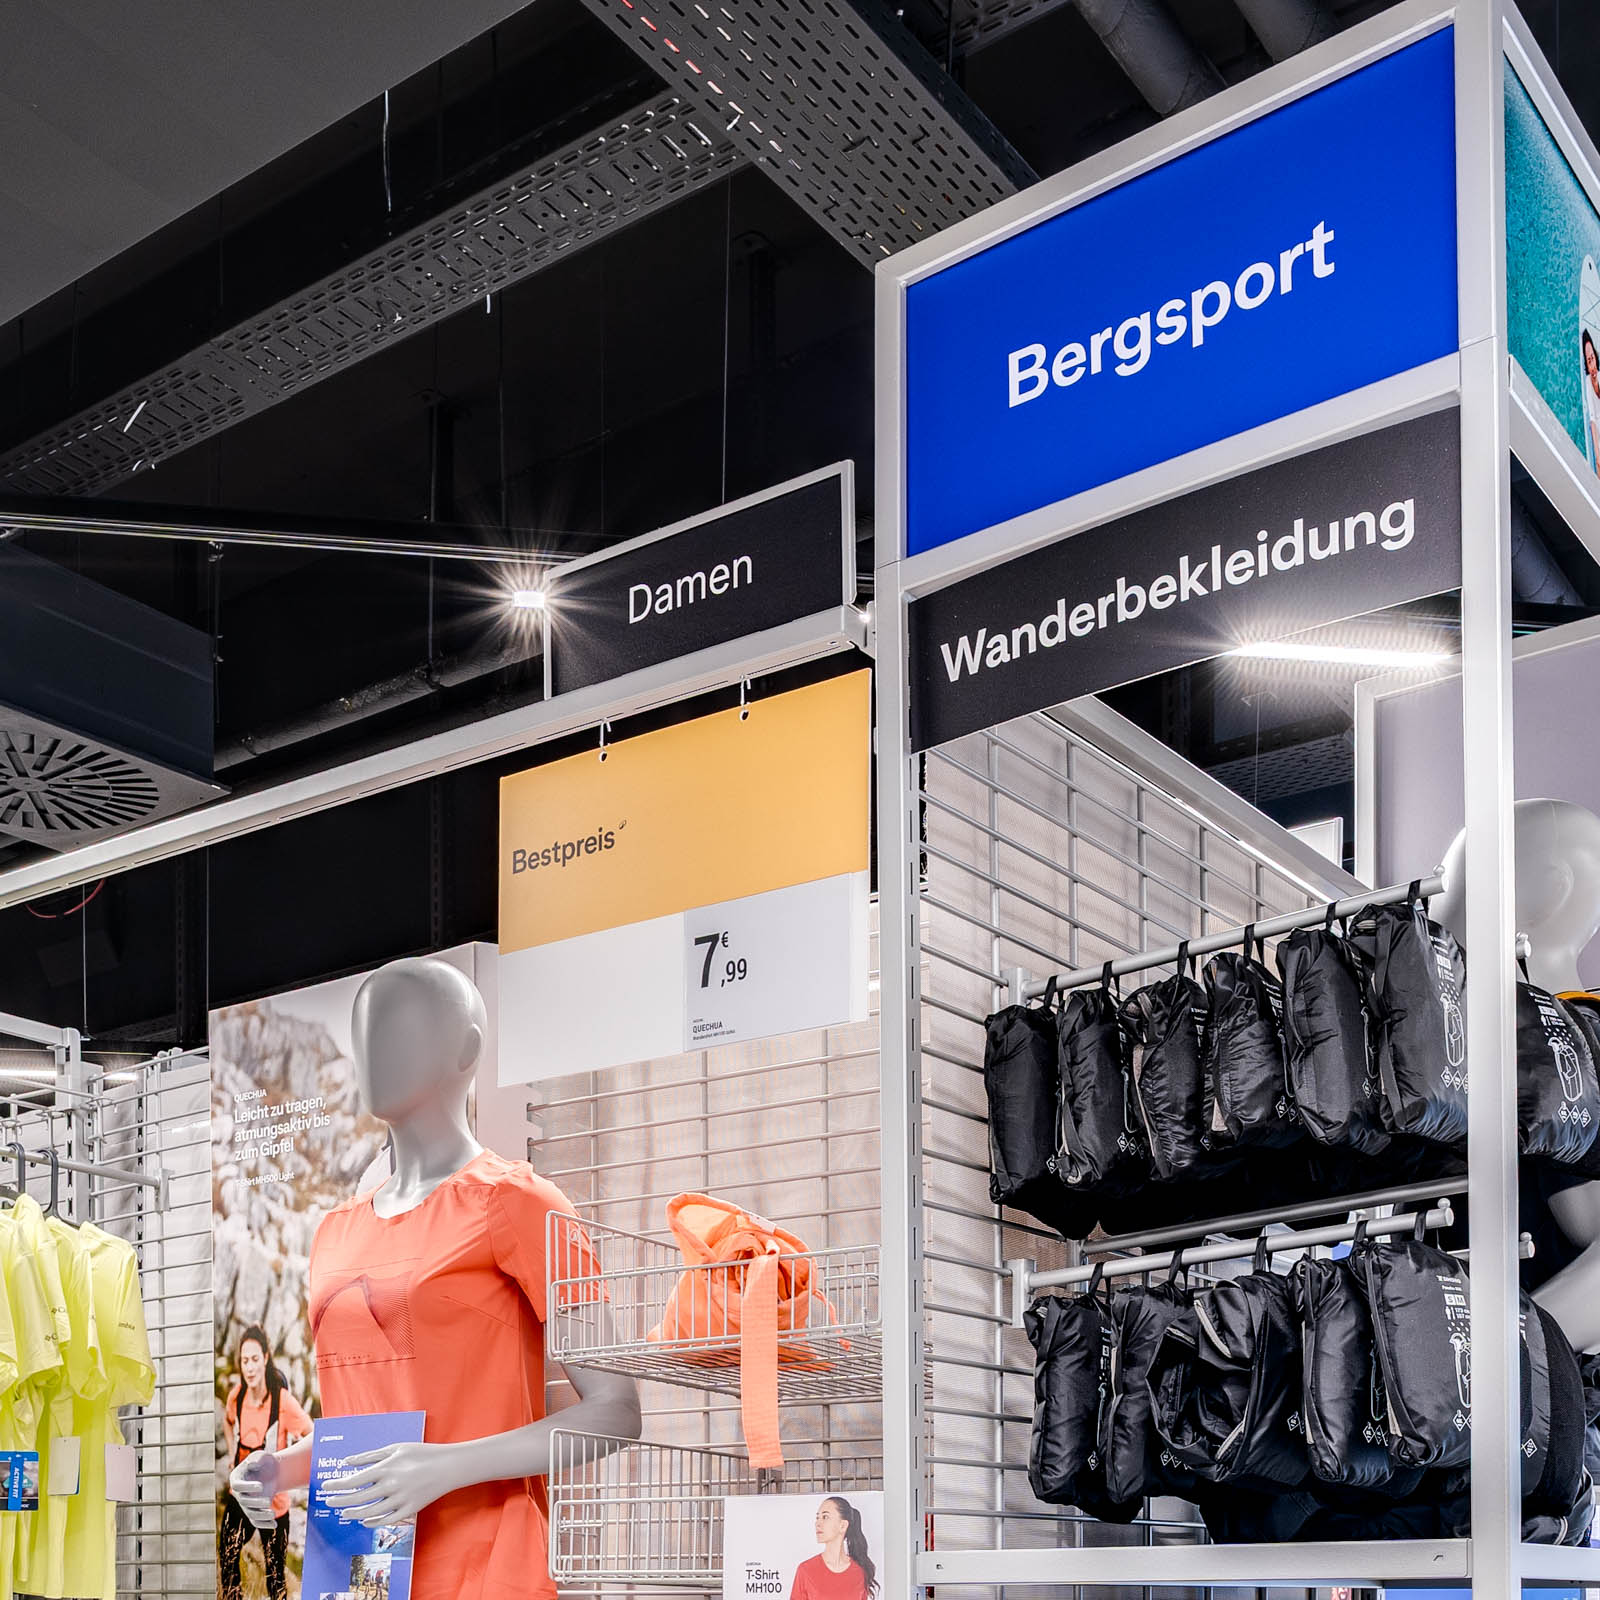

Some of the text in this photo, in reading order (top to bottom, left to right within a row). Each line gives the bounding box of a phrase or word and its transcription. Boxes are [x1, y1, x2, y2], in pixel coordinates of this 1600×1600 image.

[1006, 220, 1338, 410] Bergsport
[626, 548, 754, 625] Damen
[939, 498, 1416, 686] Wanderbekleidung
[512, 827, 616, 875] Bestpreis
[692, 1020, 723, 1034] QUECHUA
[745, 1569, 780, 1580] T-Shirt
[745, 1582, 782, 1593] MH100
